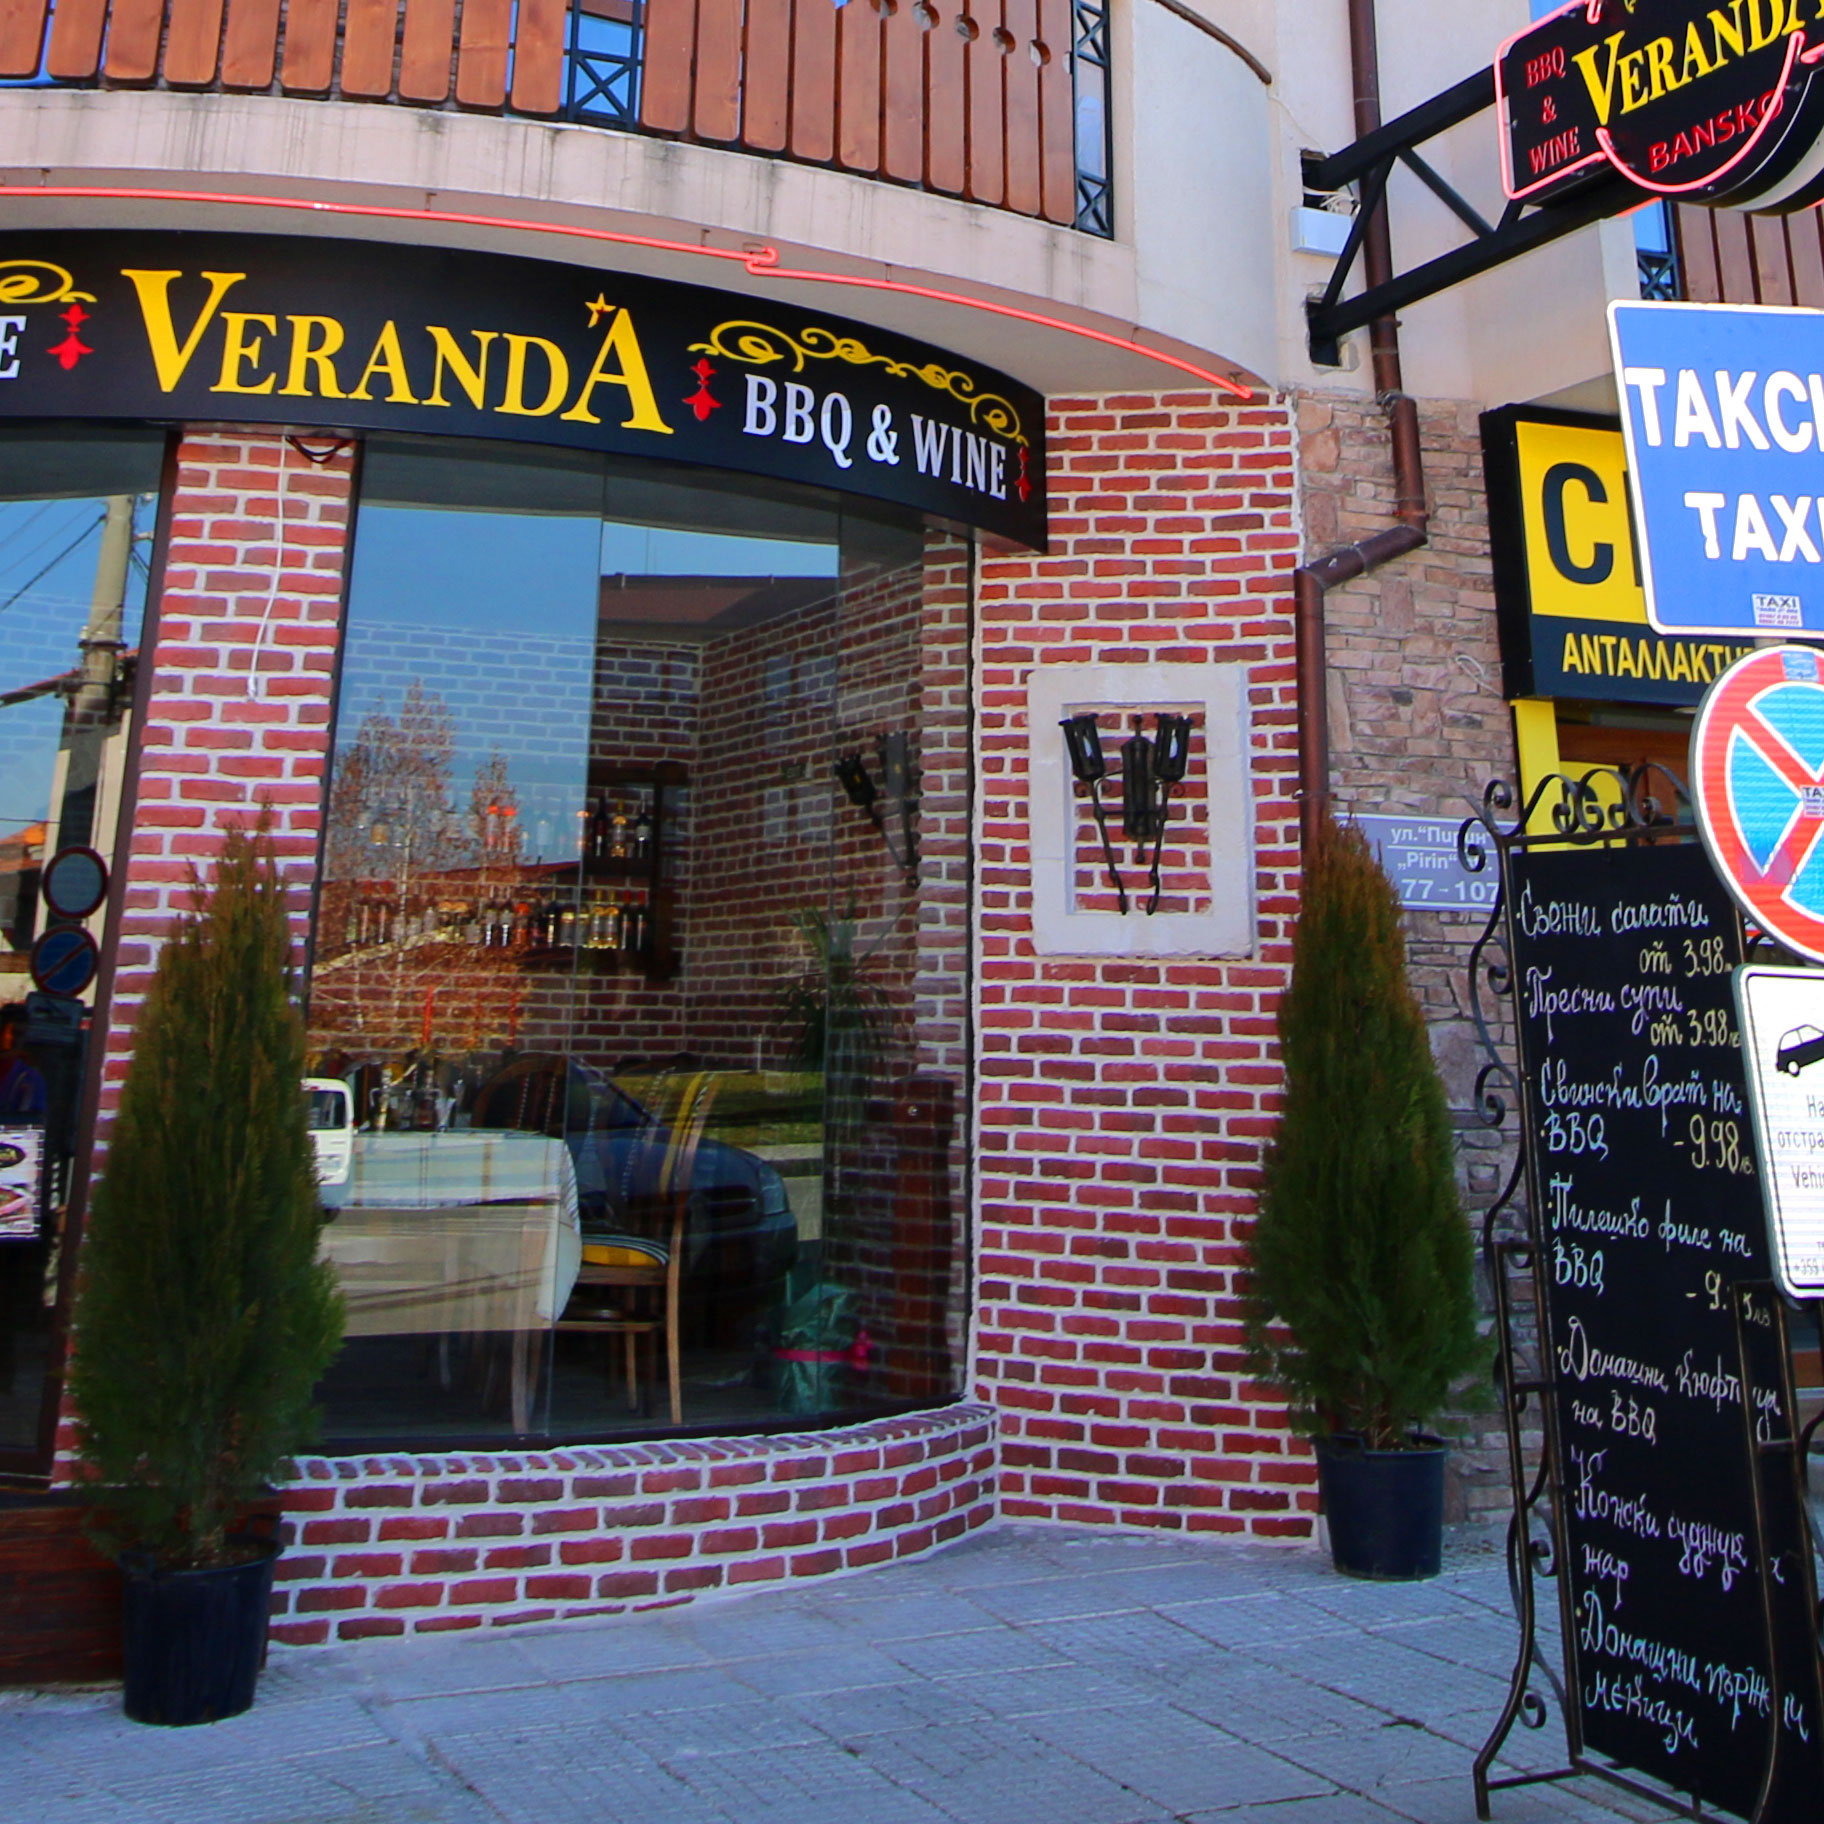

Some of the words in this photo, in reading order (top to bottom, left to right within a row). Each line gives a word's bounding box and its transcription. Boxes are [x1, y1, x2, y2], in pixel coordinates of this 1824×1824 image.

[1526, 45, 1567, 88] BBQ
[1541, 95, 1557, 124] &
[1648, 89, 1784, 173] BANSKO
[1528, 126, 1581, 175] WINE
[120, 268, 675, 436] VERANDA
[742, 373, 853, 470] BBQ
[866, 403, 900, 466] &
[910, 414, 1007, 501] WINE
[1756, 596, 1798, 608] TAXI
[1563, 632, 1758, 685] ΑΝΤΑΛΛΑΚΤΗ
[1401, 879, 1435, 900] 77
[1454, 880, 1499, 903] 107
[1545, 1109, 1609, 1162] BBQ
[1552, 1236, 1605, 1297] BBQ
